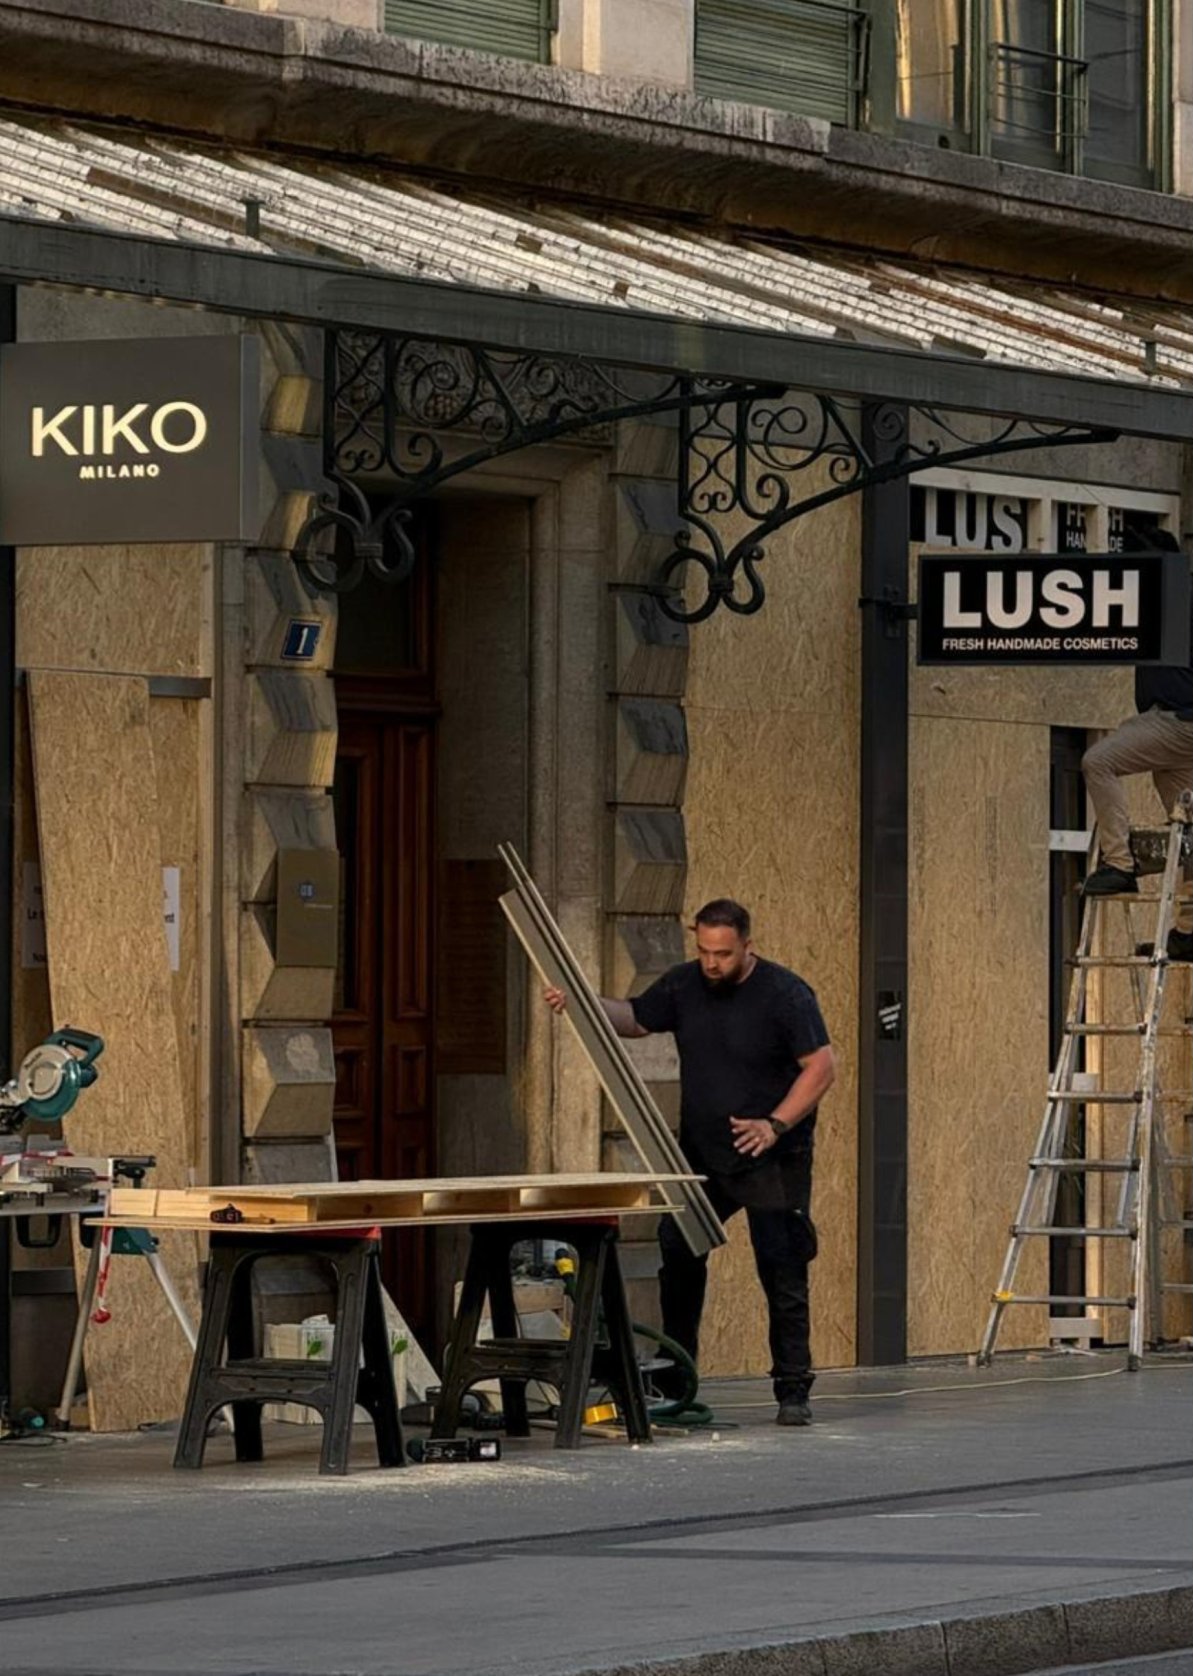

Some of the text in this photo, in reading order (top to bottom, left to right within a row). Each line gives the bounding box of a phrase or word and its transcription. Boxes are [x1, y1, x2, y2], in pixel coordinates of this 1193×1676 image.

[32, 401, 208, 457] KIKO
[79, 463, 161, 479] MILANO
[925, 487, 1058, 553] LUS
[943, 569, 1140, 630] LUSH
[296, 627, 309, 655] 1
[942, 637, 1138, 650] FRESH HANDMADE COSMETICS
